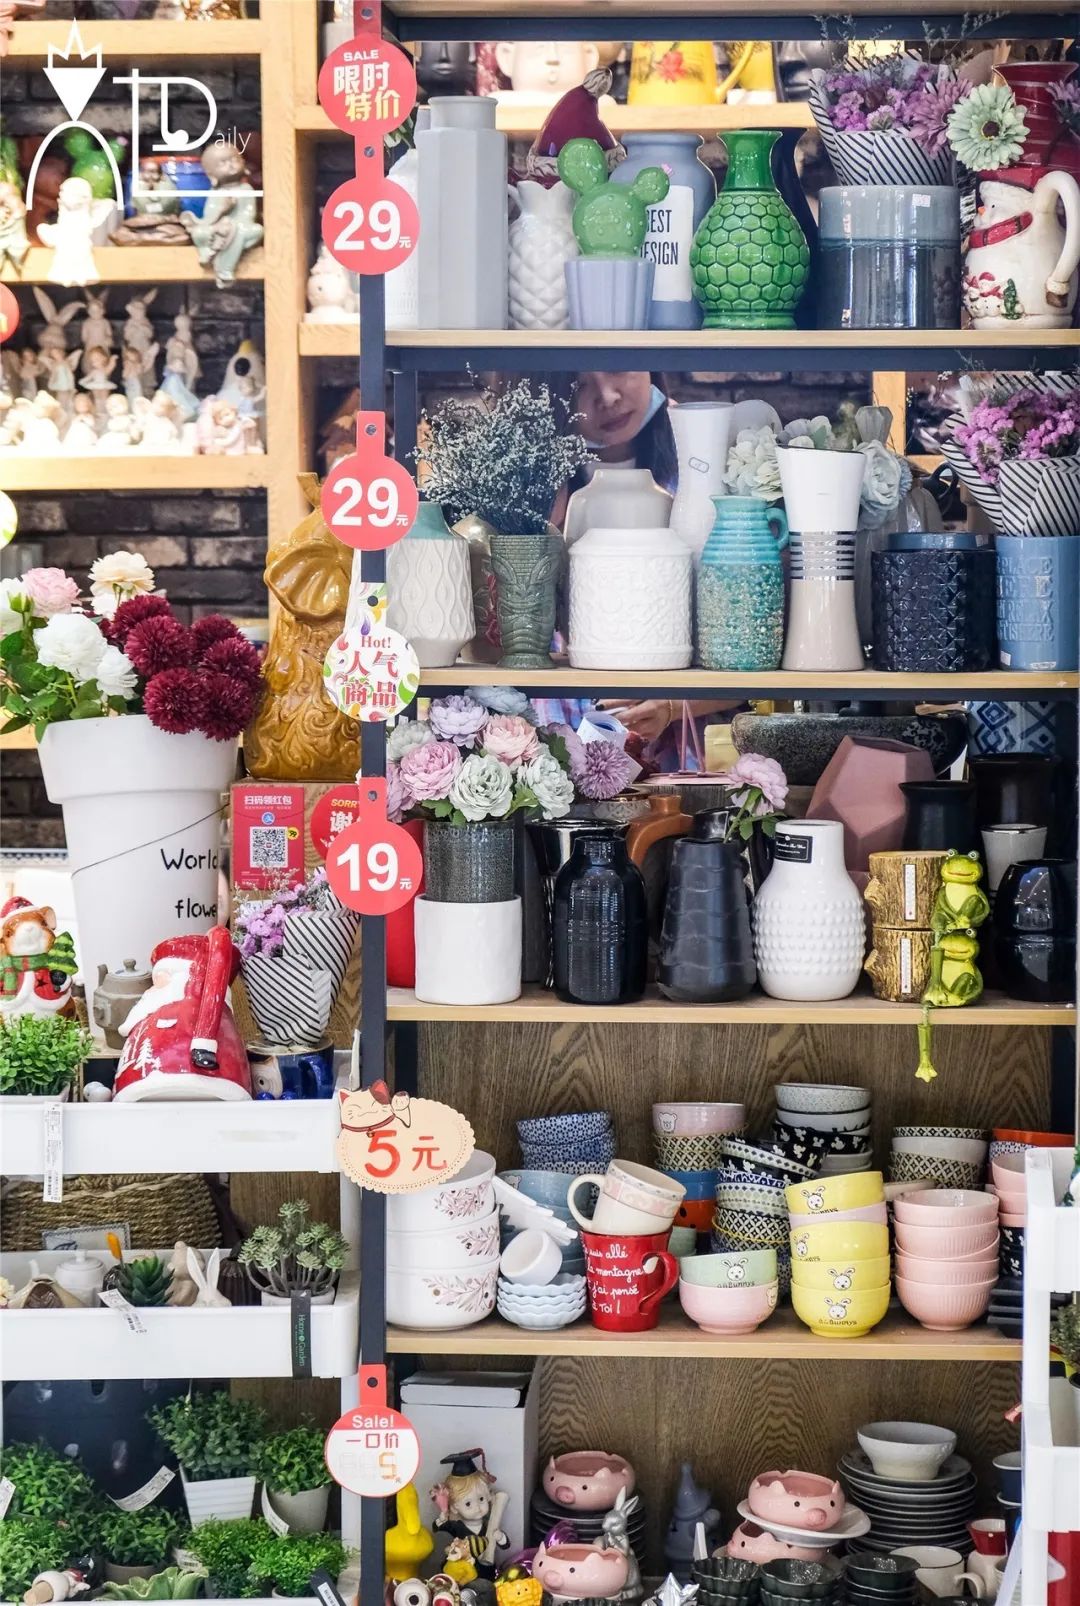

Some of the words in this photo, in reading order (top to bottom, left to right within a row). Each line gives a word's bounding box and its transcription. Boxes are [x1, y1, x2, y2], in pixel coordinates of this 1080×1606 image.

[343, 49, 379, 62] SALE
[333, 62, 390, 96] 限时
[345, 88, 400, 122] 特价
[640, 241, 678, 265] ESIGN
[361, 636, 391, 649] Hot!
[346, 650, 398, 677] 人气
[344, 680, 397, 706] 商品
[331, 798, 360, 808] SORR
[605, 1243, 629, 1259] allé
[595, 1265, 644, 1283] montagne
[352, 1414, 394, 1429] Sale!
[346, 1432, 399, 1449] 一口价
